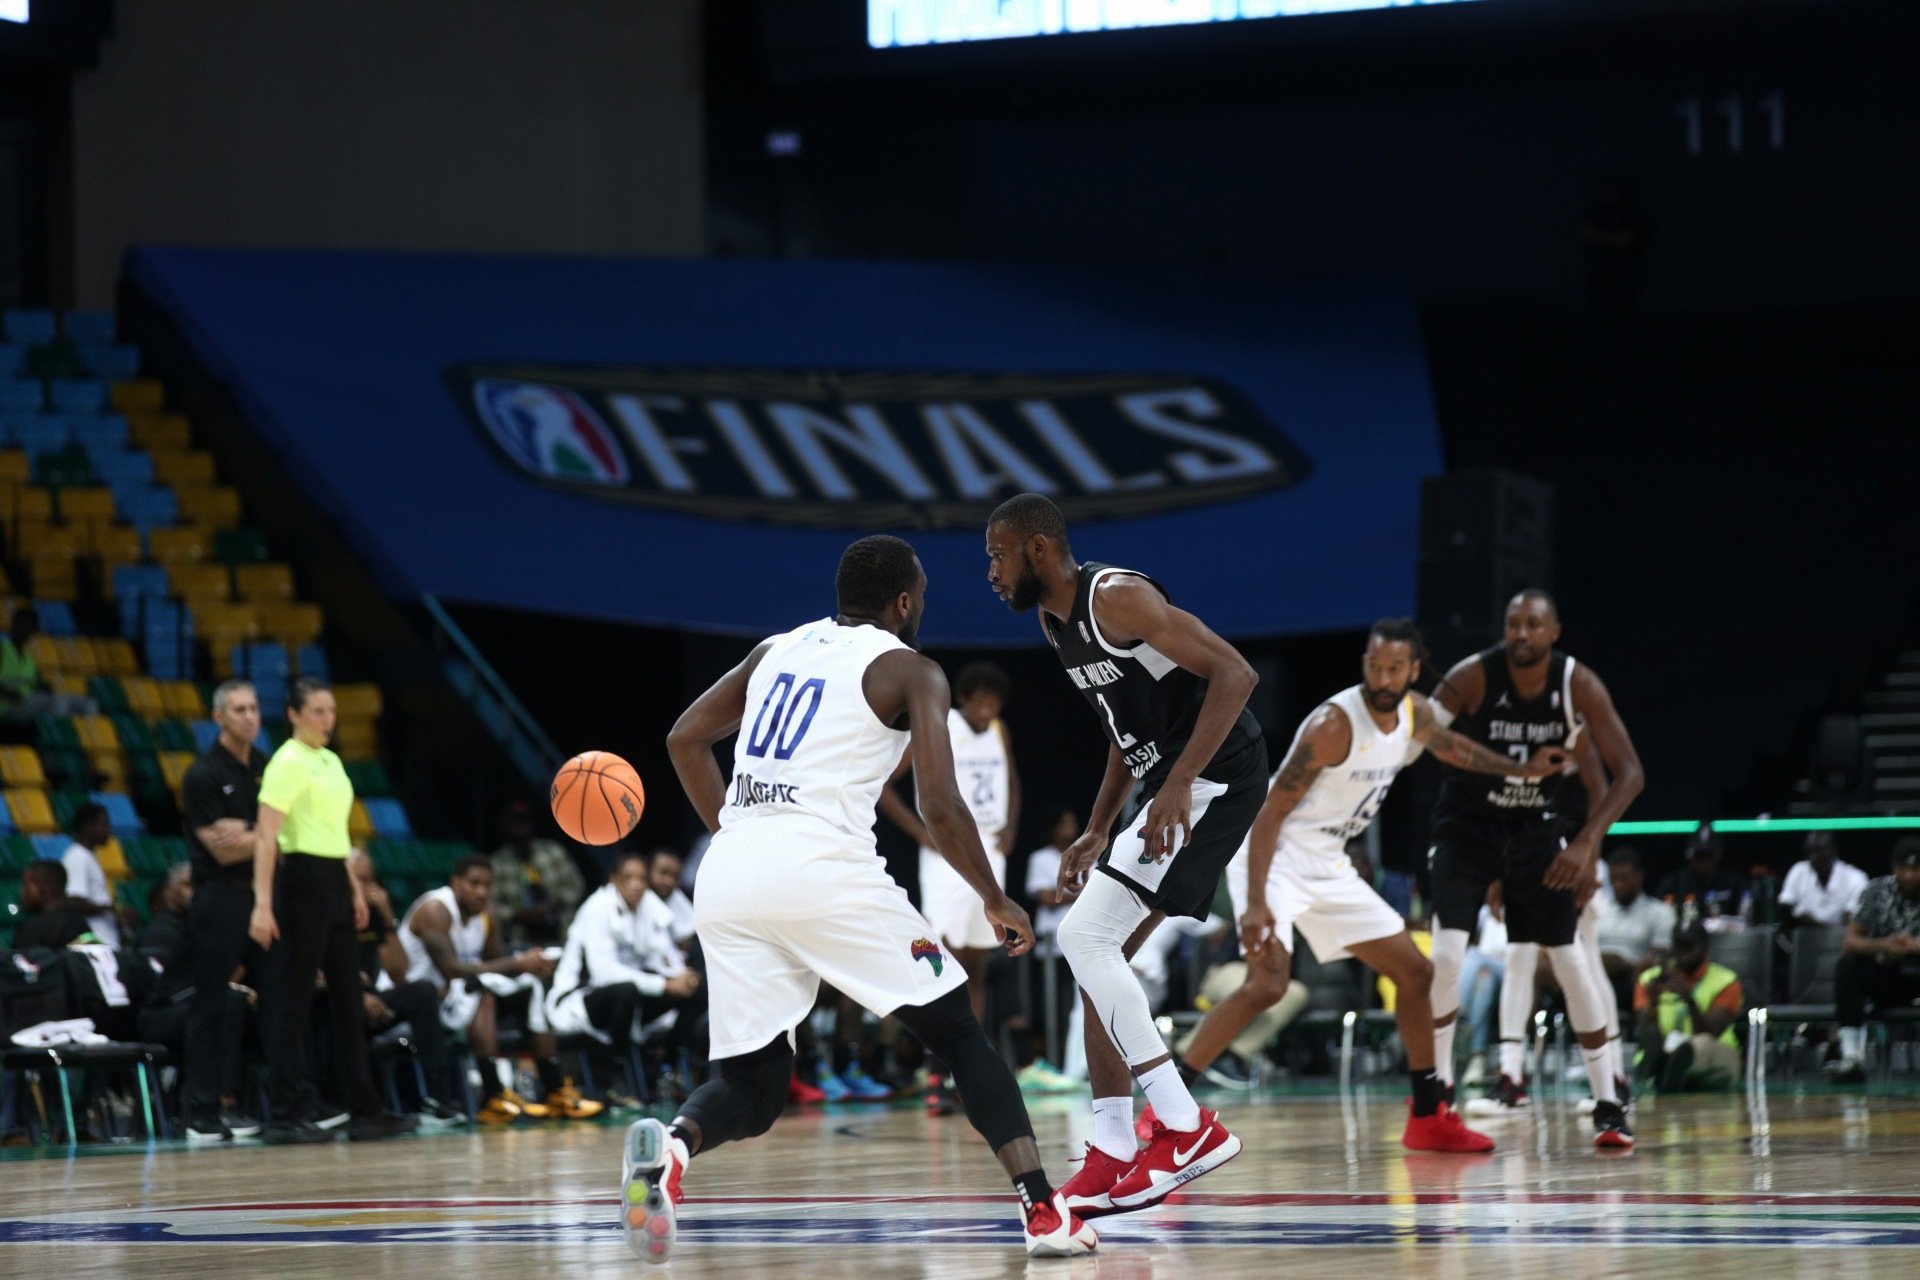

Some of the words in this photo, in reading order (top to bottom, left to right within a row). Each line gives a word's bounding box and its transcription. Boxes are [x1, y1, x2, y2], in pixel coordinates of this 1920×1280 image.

[1674, 93, 1785, 155] 111
[606, 386, 1281, 500] FINALS
[746, 672, 826, 760] 00
[1096, 692, 1138, 749] 2
[1123, 741, 1158, 766] VISIT
